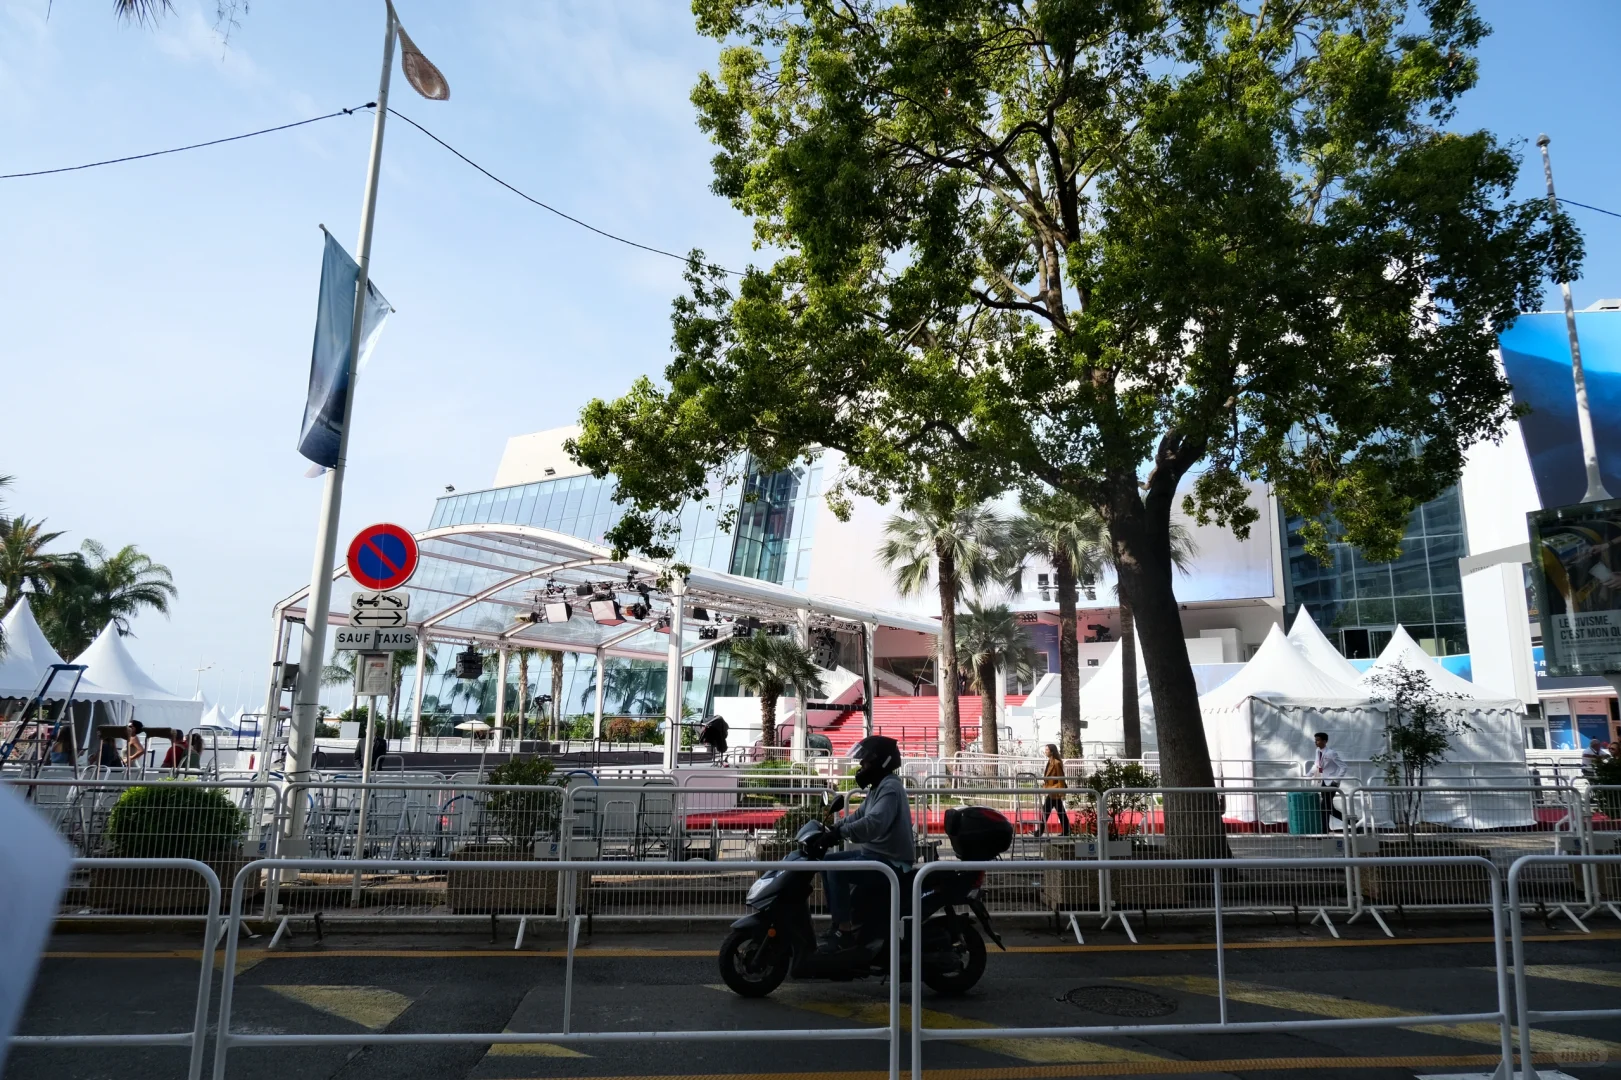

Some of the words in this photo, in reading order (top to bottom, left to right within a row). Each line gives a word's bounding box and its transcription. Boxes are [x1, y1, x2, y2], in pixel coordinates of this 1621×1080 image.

[1559, 618, 1570, 628] LE
[1587, 627, 1609, 638] MON
[338, 633, 371, 643] SAUF
[376, 633, 412, 643] TAXIS
